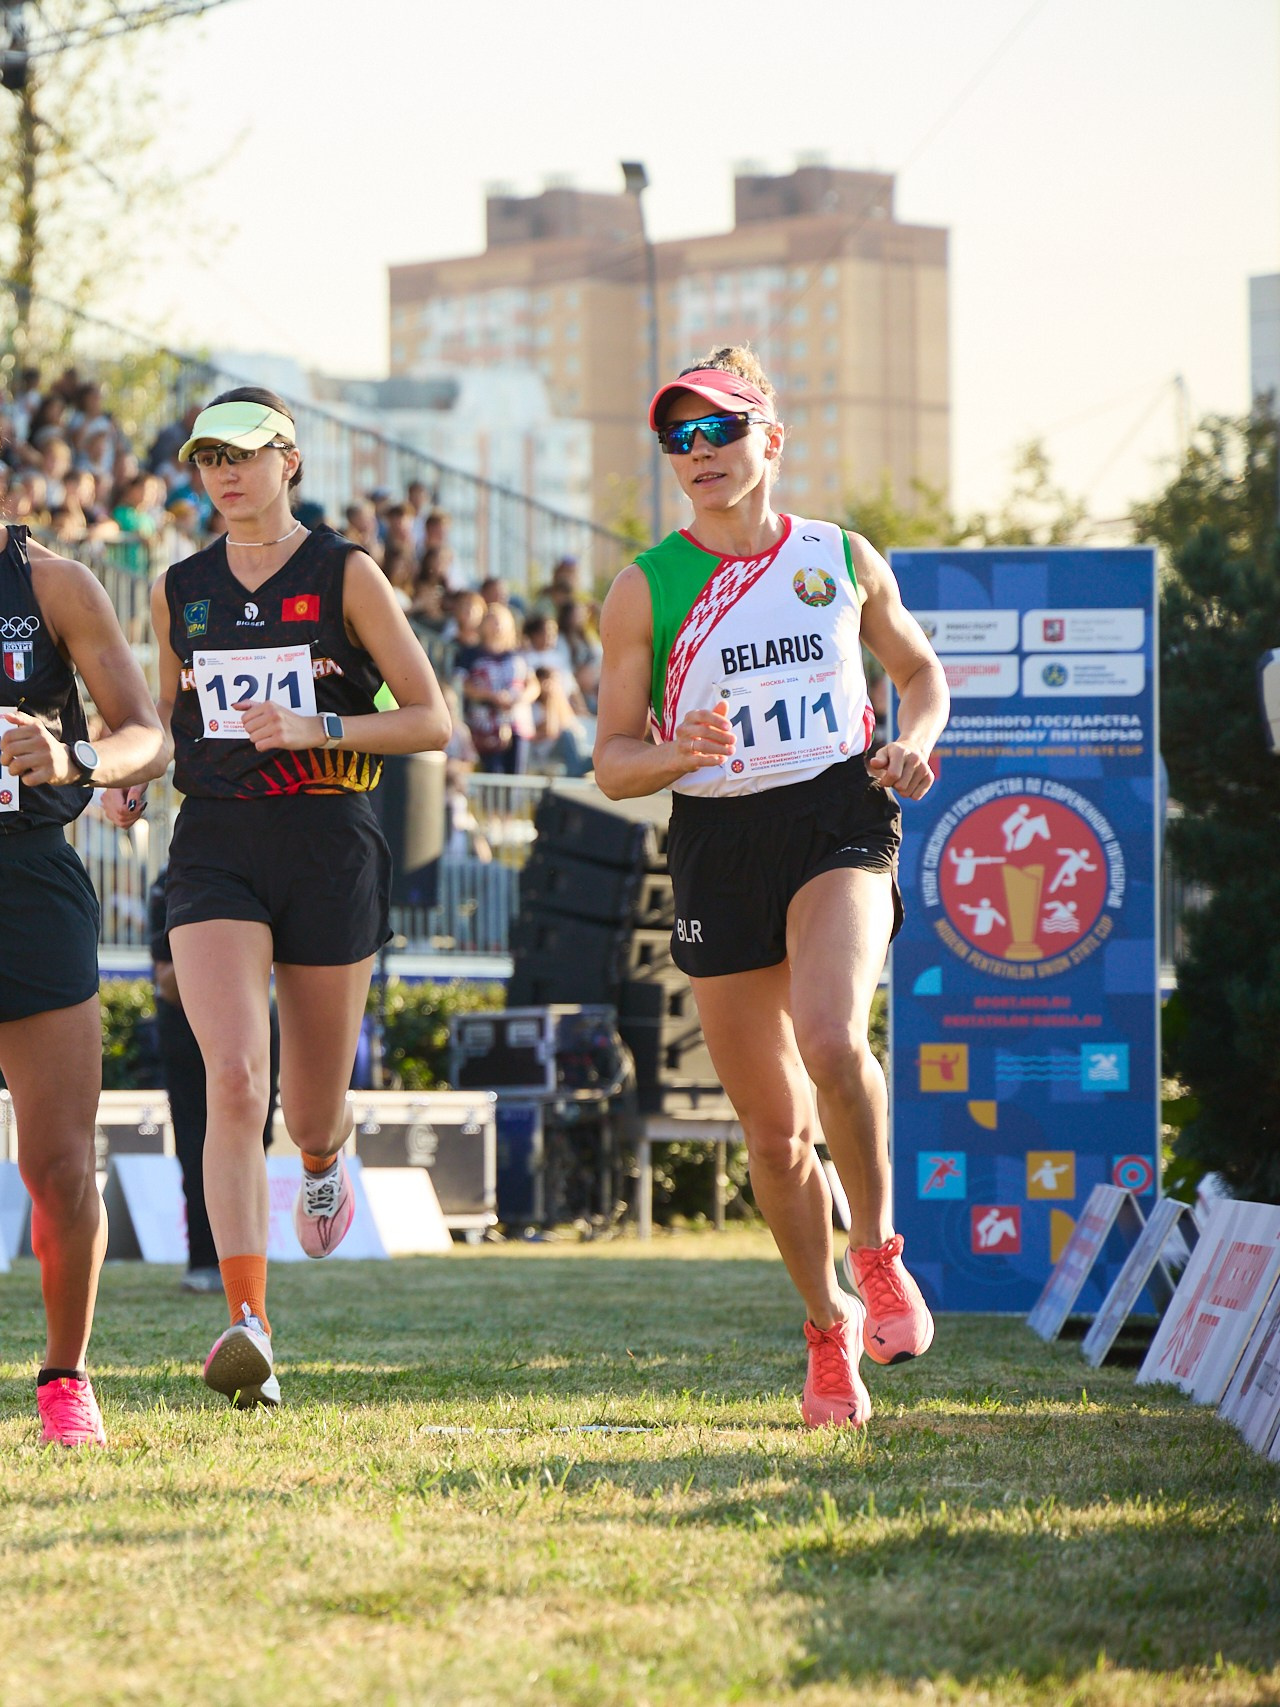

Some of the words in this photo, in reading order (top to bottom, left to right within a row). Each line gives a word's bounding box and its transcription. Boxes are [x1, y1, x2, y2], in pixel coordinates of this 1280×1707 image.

[721, 633, 824, 676] BELARUS
[944, 664, 1000, 675] ОСКОВСКИЙ
[205, 671, 301, 711] 12/1
[760, 679, 785, 687] МОСКВА
[730, 692, 839, 748] 11/1
[950, 715, 1032, 729] СОЮЗНОГО
[1034, 714, 1140, 728] ГОСУДАРСТВА
[1050, 729, 1143, 742] ПЯТИБОРЬЮ
[677, 918, 704, 944] BLR
